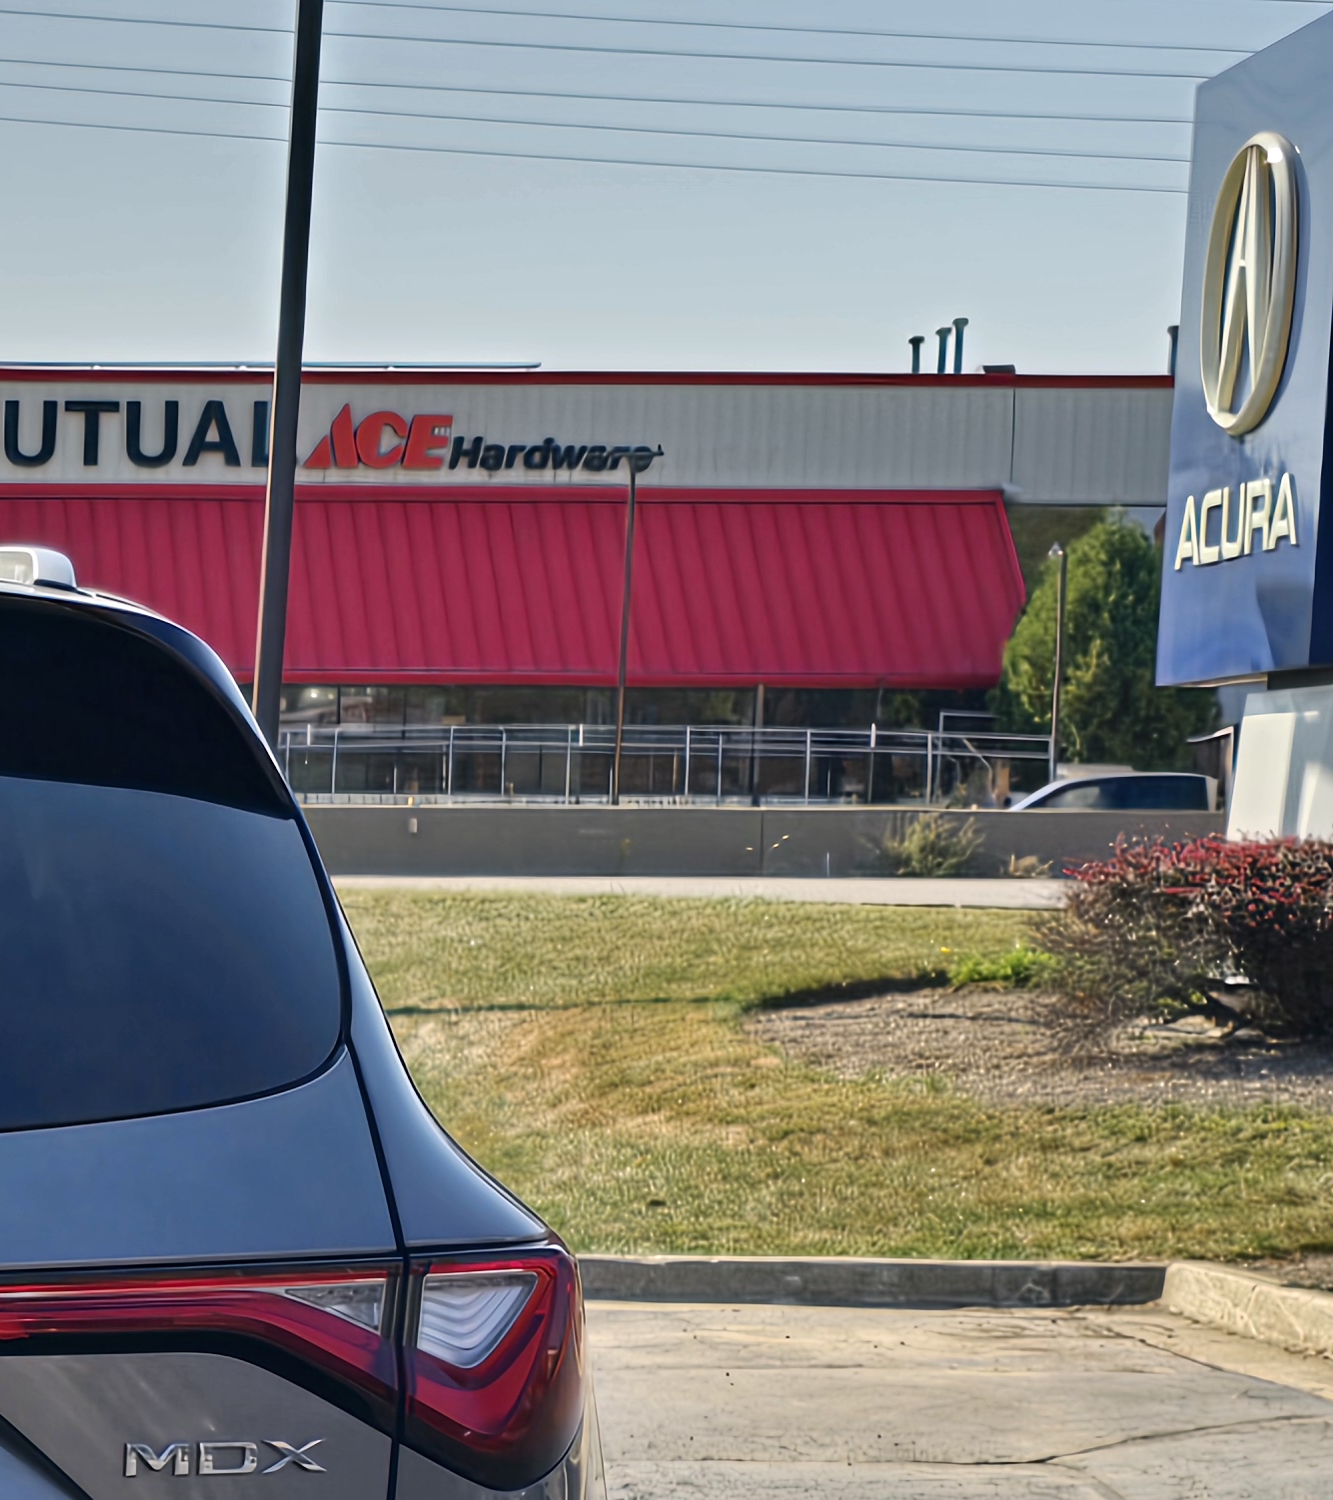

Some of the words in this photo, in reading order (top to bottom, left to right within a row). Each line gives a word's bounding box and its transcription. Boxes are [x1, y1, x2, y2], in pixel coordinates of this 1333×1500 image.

[302, 403, 453, 470] ACE
[1174, 471, 1297, 571] ACURA
[123, 1438, 327, 1477] MDX
